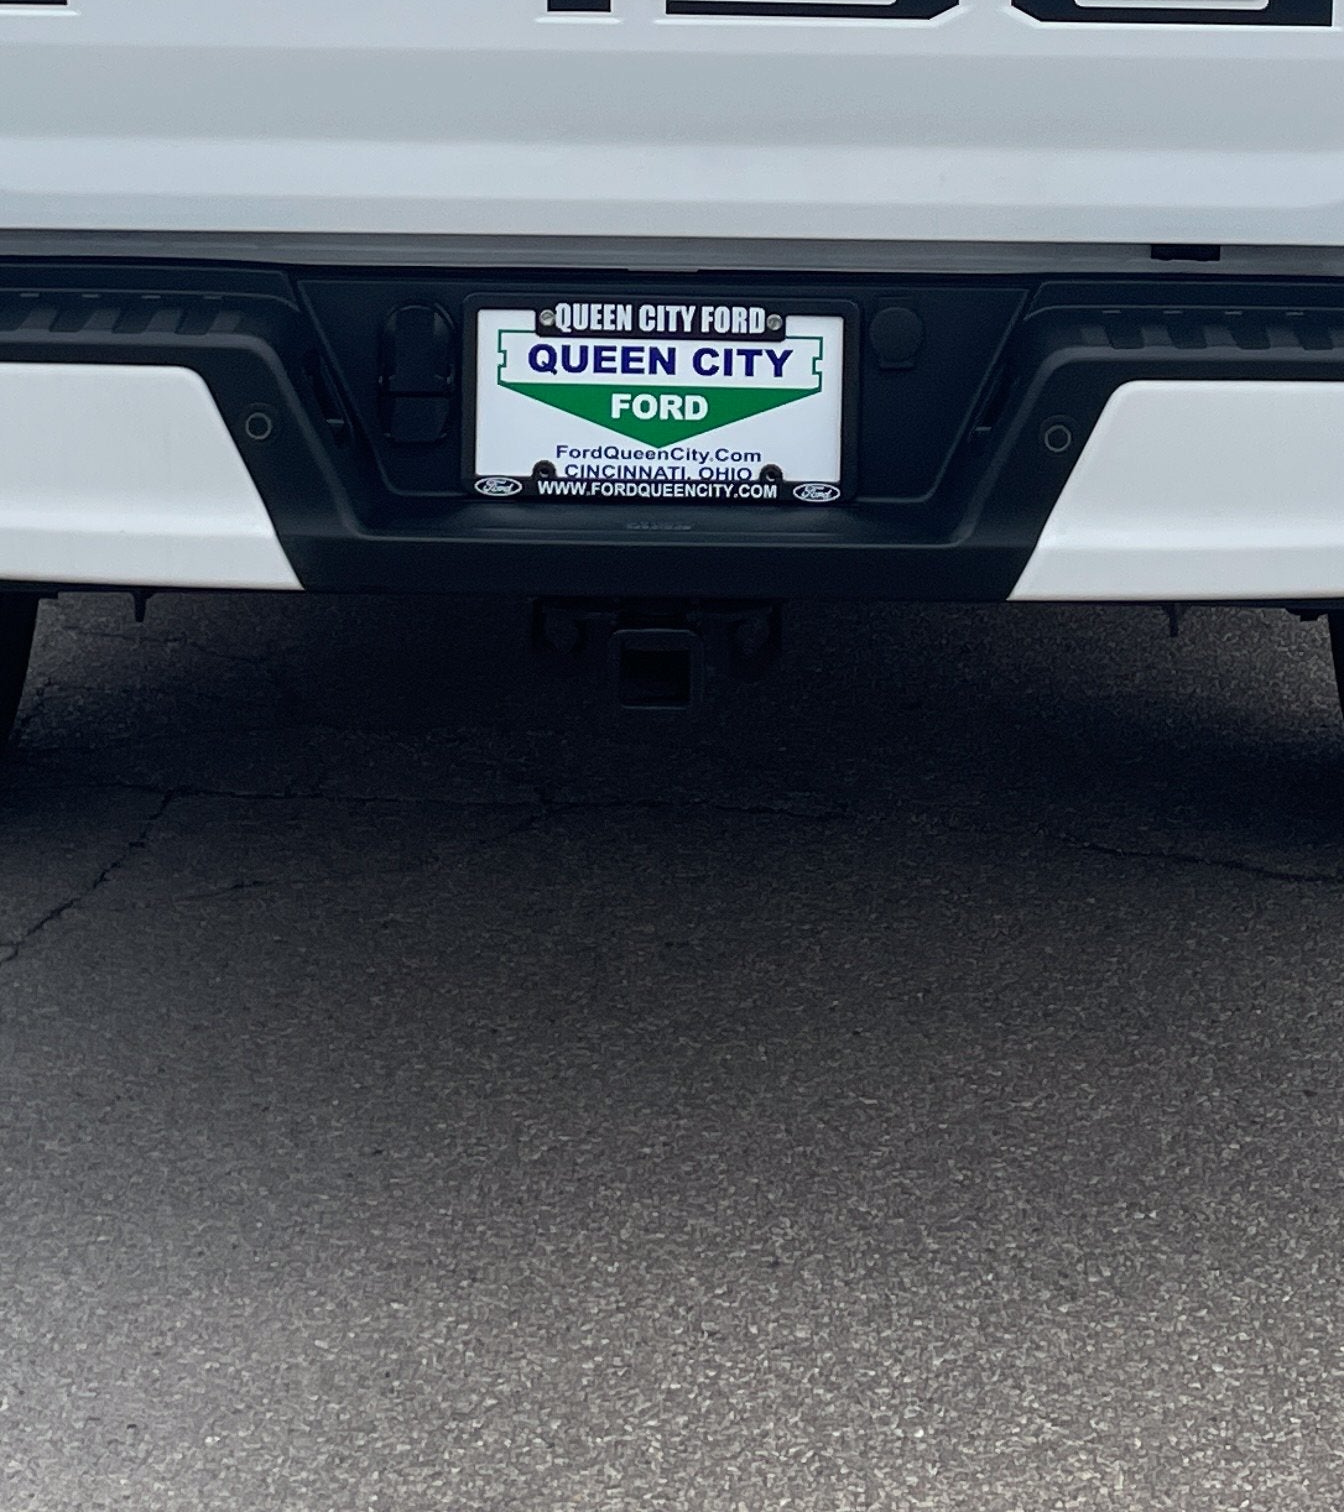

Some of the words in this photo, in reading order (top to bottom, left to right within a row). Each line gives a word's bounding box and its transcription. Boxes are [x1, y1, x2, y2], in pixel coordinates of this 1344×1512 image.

[556, 303, 632, 332] QUEEN
[638, 305, 697, 333] CITY
[701, 306, 766, 335] FORD
[528, 343, 676, 376] QUEEN
[692, 347, 794, 377] CITY
[611, 393, 709, 421] FORD
[556, 444, 762, 465] FordQueenCity.Com
[698, 467, 753, 482] OHIO
[537, 480, 778, 499] WWW.FORDQUEENCITY.COM
